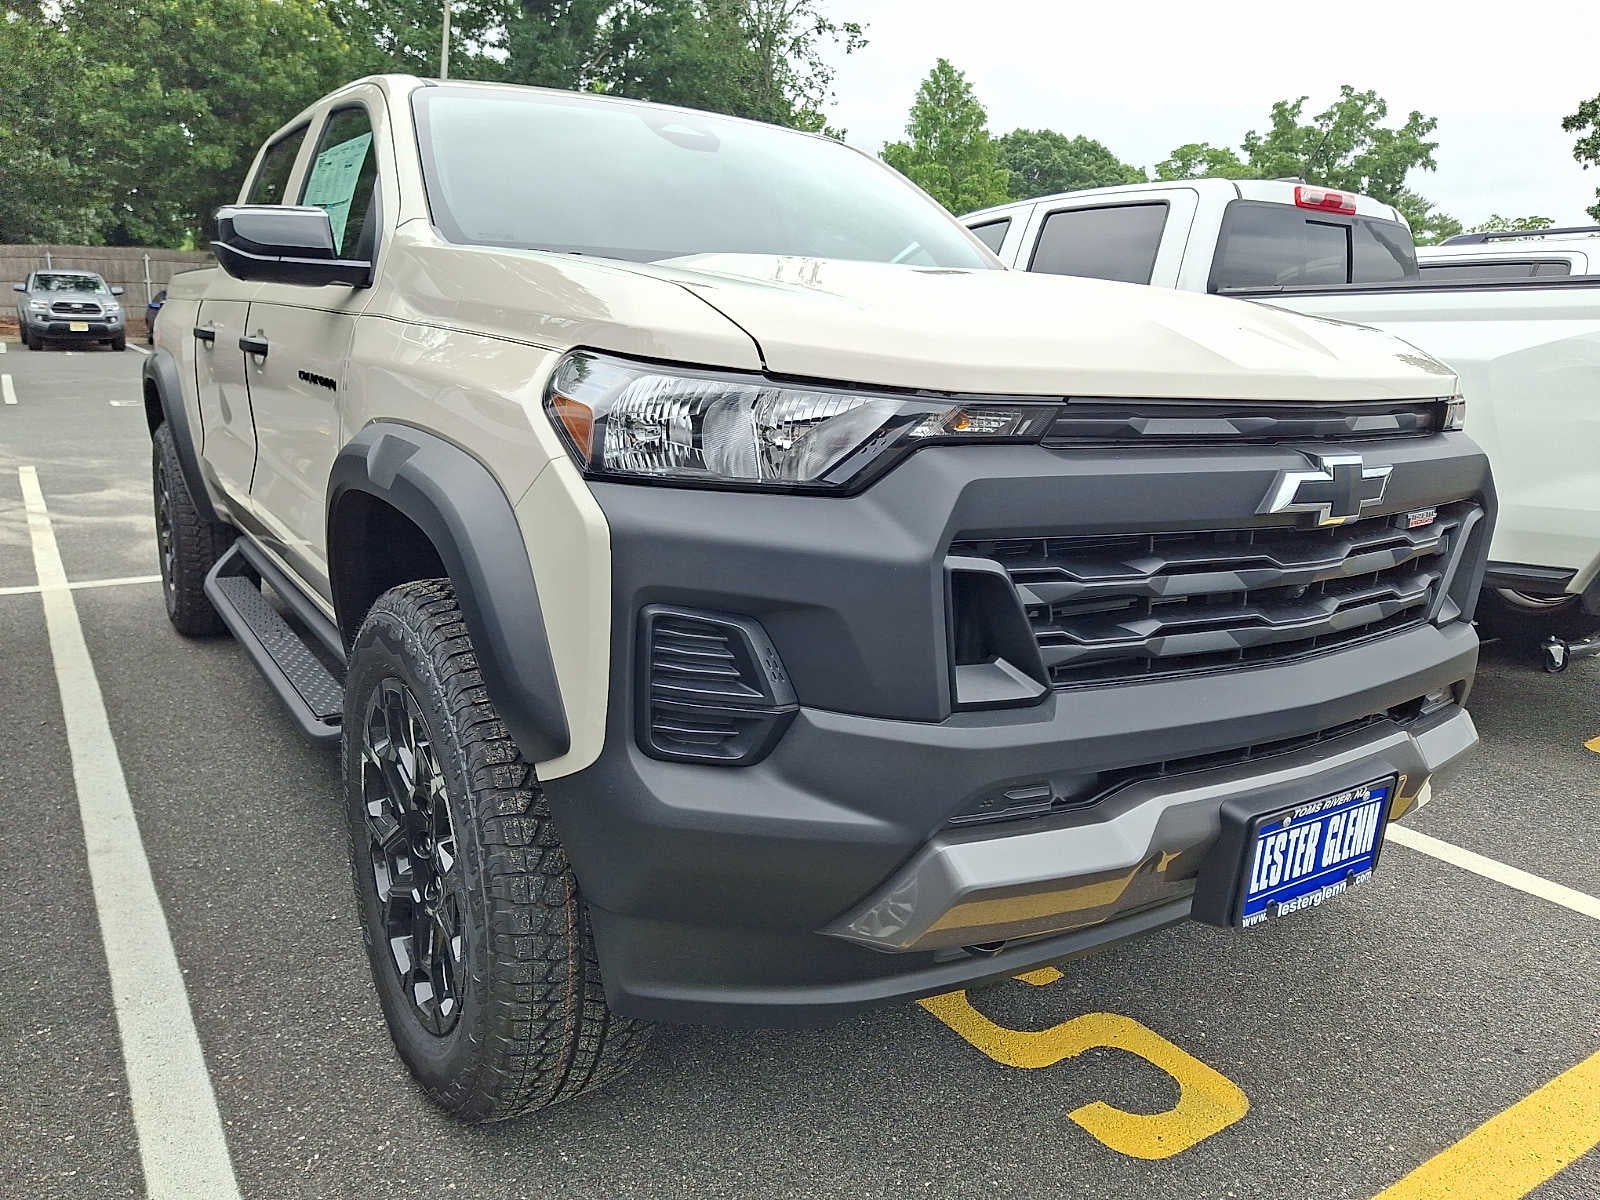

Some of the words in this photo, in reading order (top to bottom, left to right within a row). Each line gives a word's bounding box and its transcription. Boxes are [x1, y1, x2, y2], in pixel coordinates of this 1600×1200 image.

[1293, 802, 1323, 819] TOMS
[1249, 821, 1322, 894] LESTER
[1321, 801, 1381, 868] GLENN
